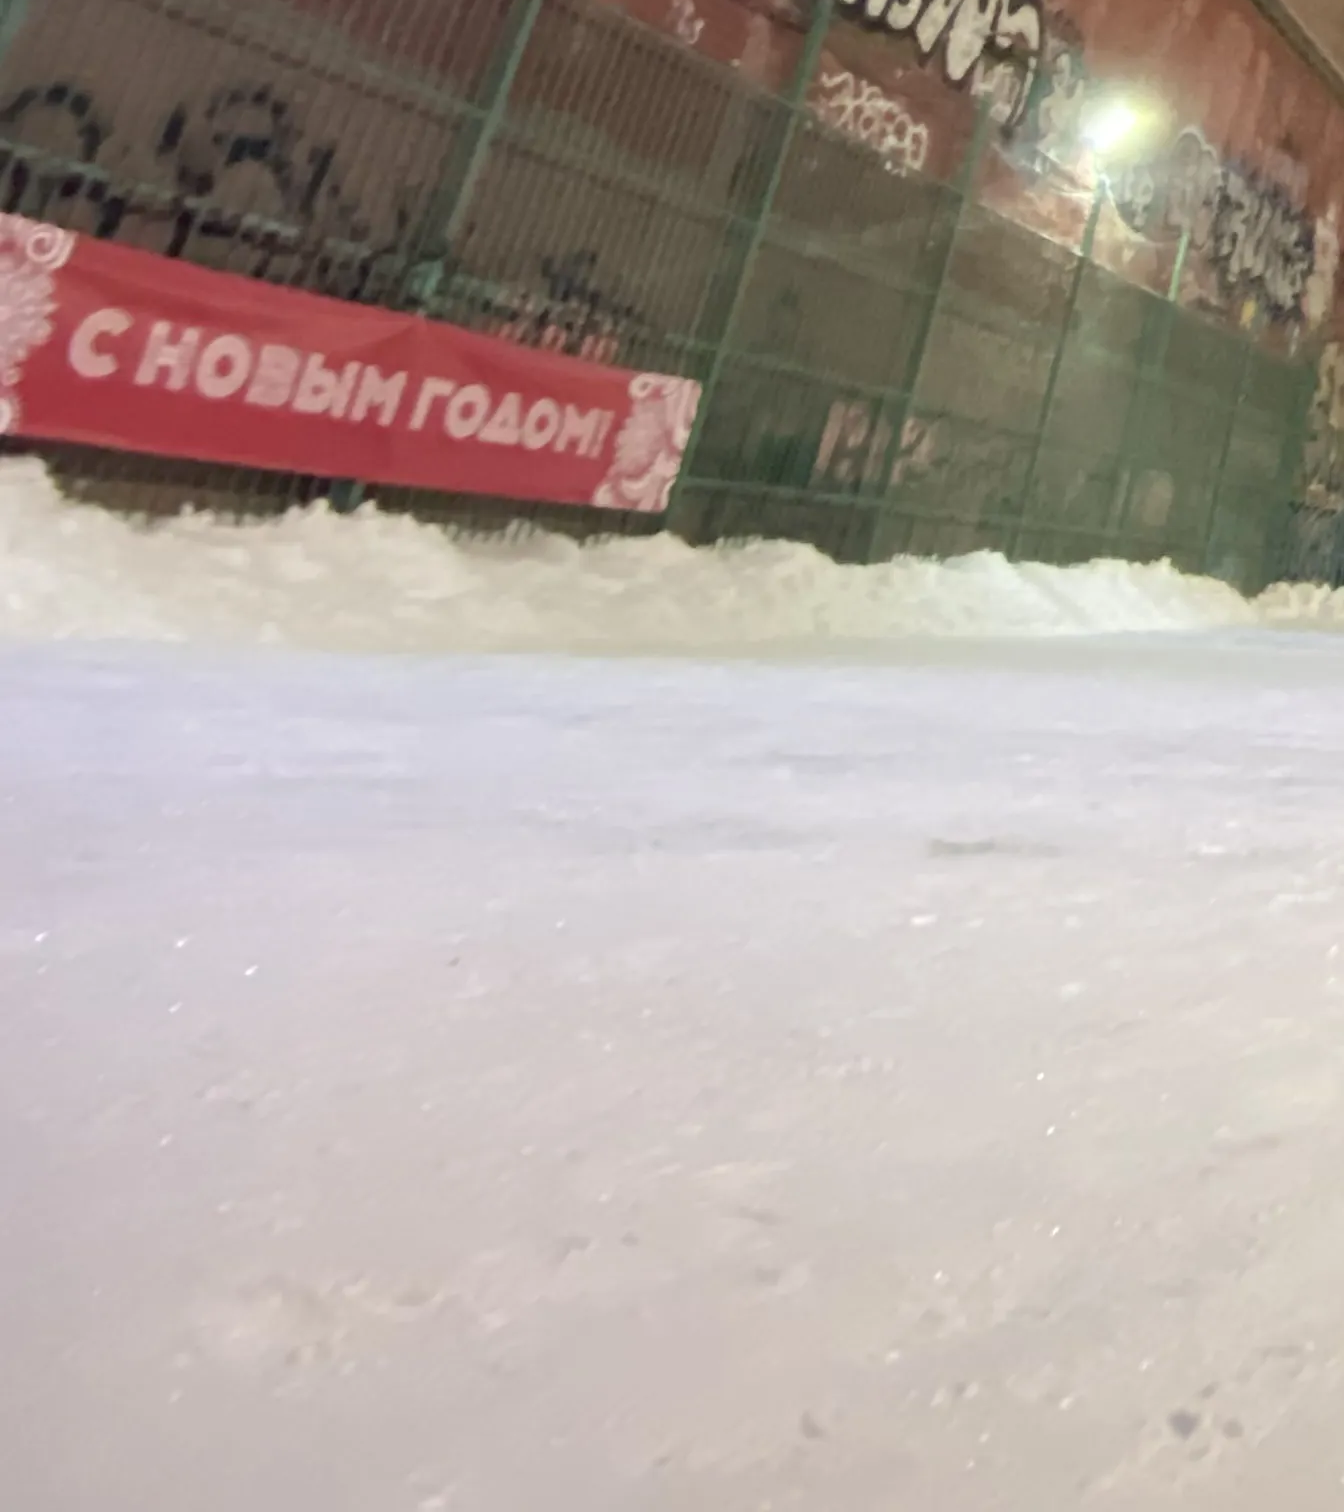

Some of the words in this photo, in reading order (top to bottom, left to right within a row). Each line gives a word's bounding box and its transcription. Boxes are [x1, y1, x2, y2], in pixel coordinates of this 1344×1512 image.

[68, 308, 134, 378] С
[133, 320, 409, 428] НОВЫМ
[408, 376, 616, 460] ГОДОМ!
